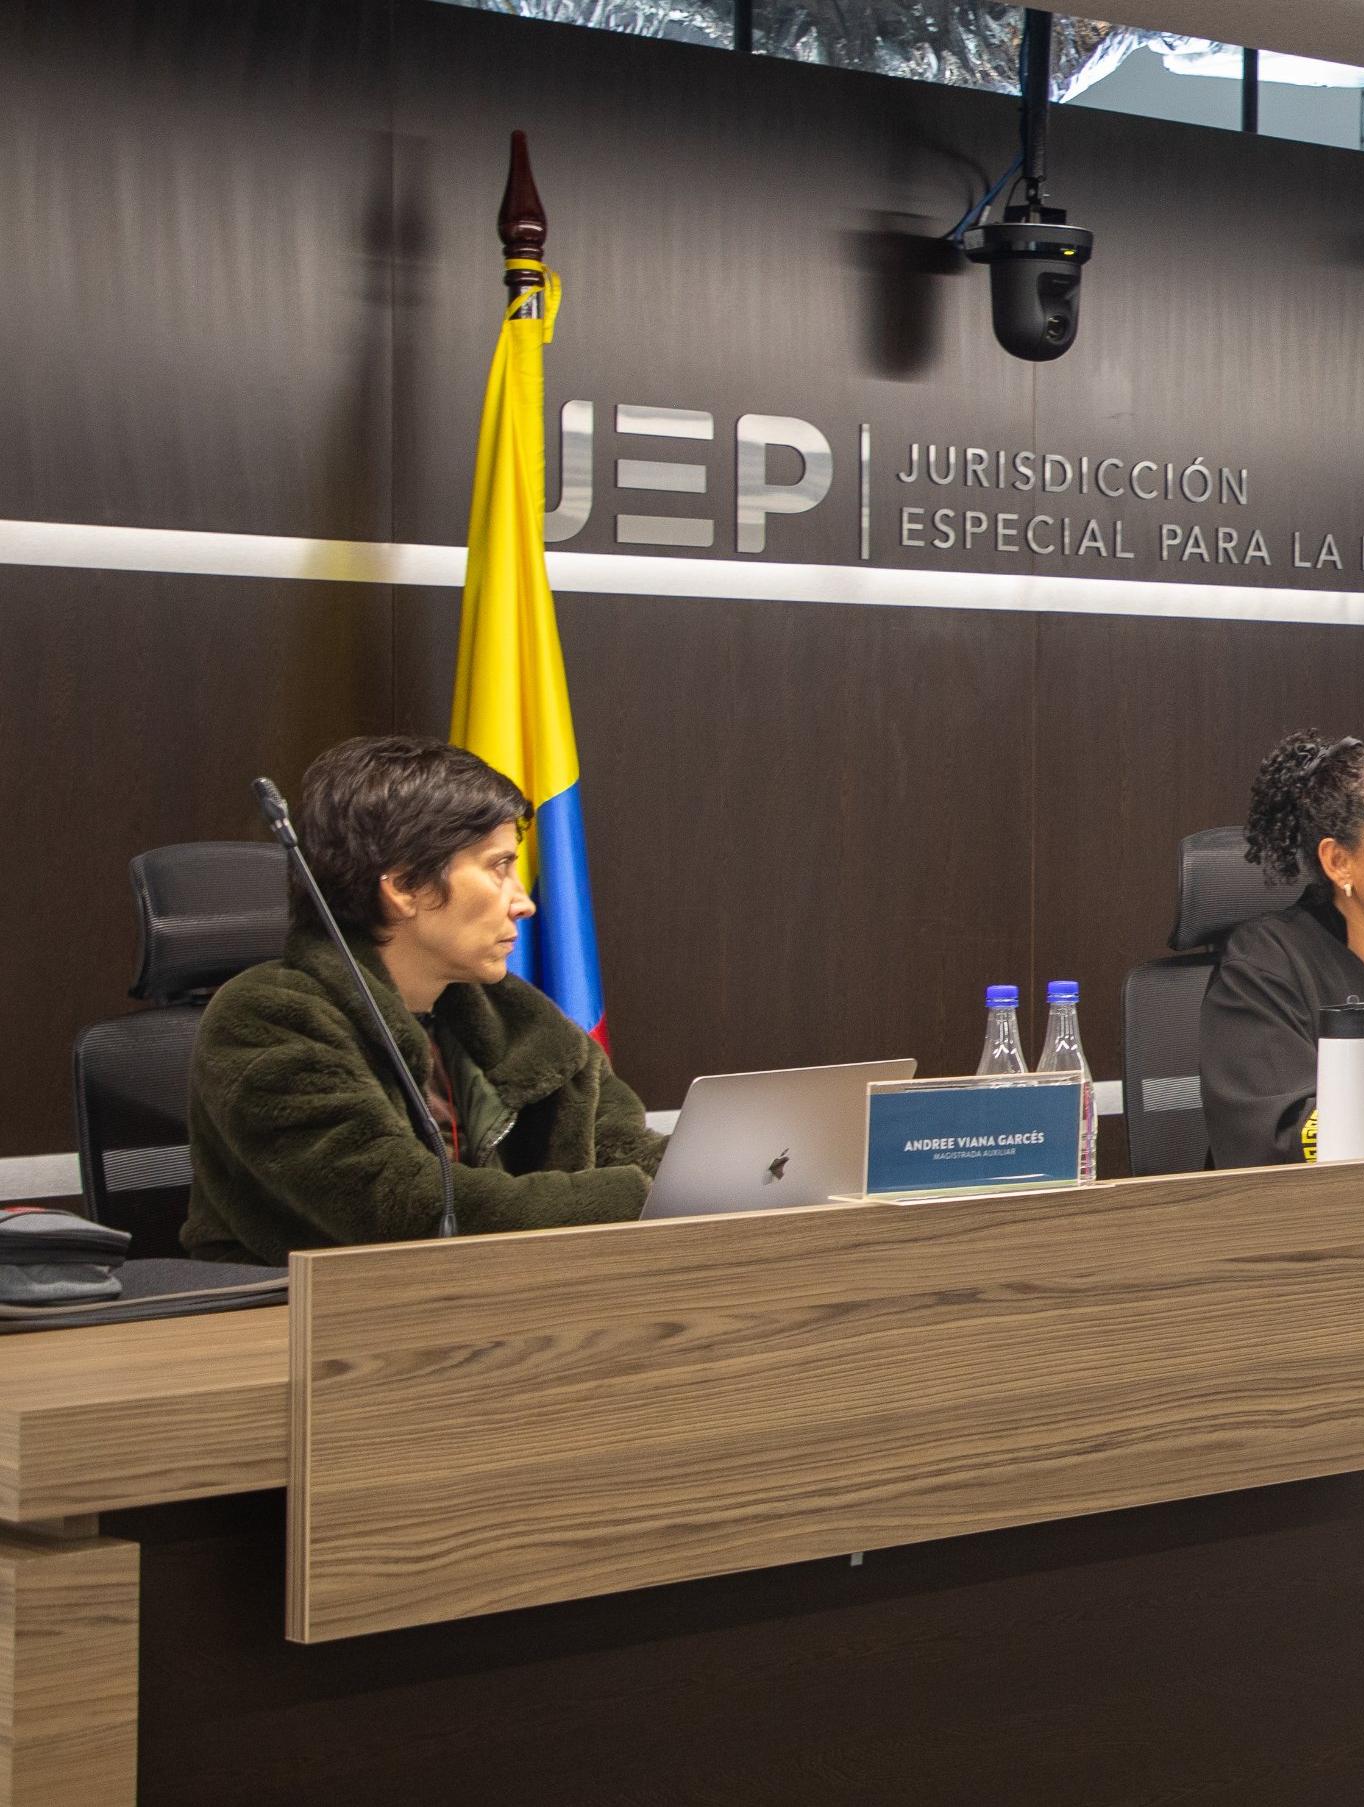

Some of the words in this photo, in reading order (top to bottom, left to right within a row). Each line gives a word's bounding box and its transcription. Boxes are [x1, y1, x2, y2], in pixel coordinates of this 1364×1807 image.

[543, 400, 833, 554] JEP
[897, 443, 1249, 505] JURISDICCIÓN
[901, 506, 1135, 559] ESPECIAL
[1161, 523, 1272, 566] PARA
[1294, 531, 1343, 570] LA
[904, 1137, 955, 1152] ANDREE
[957, 1135, 996, 1148] VIANA
[998, 1130, 1045, 1145] GARCÉS
[933, 1150, 982, 1160] MAGISTRADA
[983, 1148, 1016, 1158] AUXILIAR
